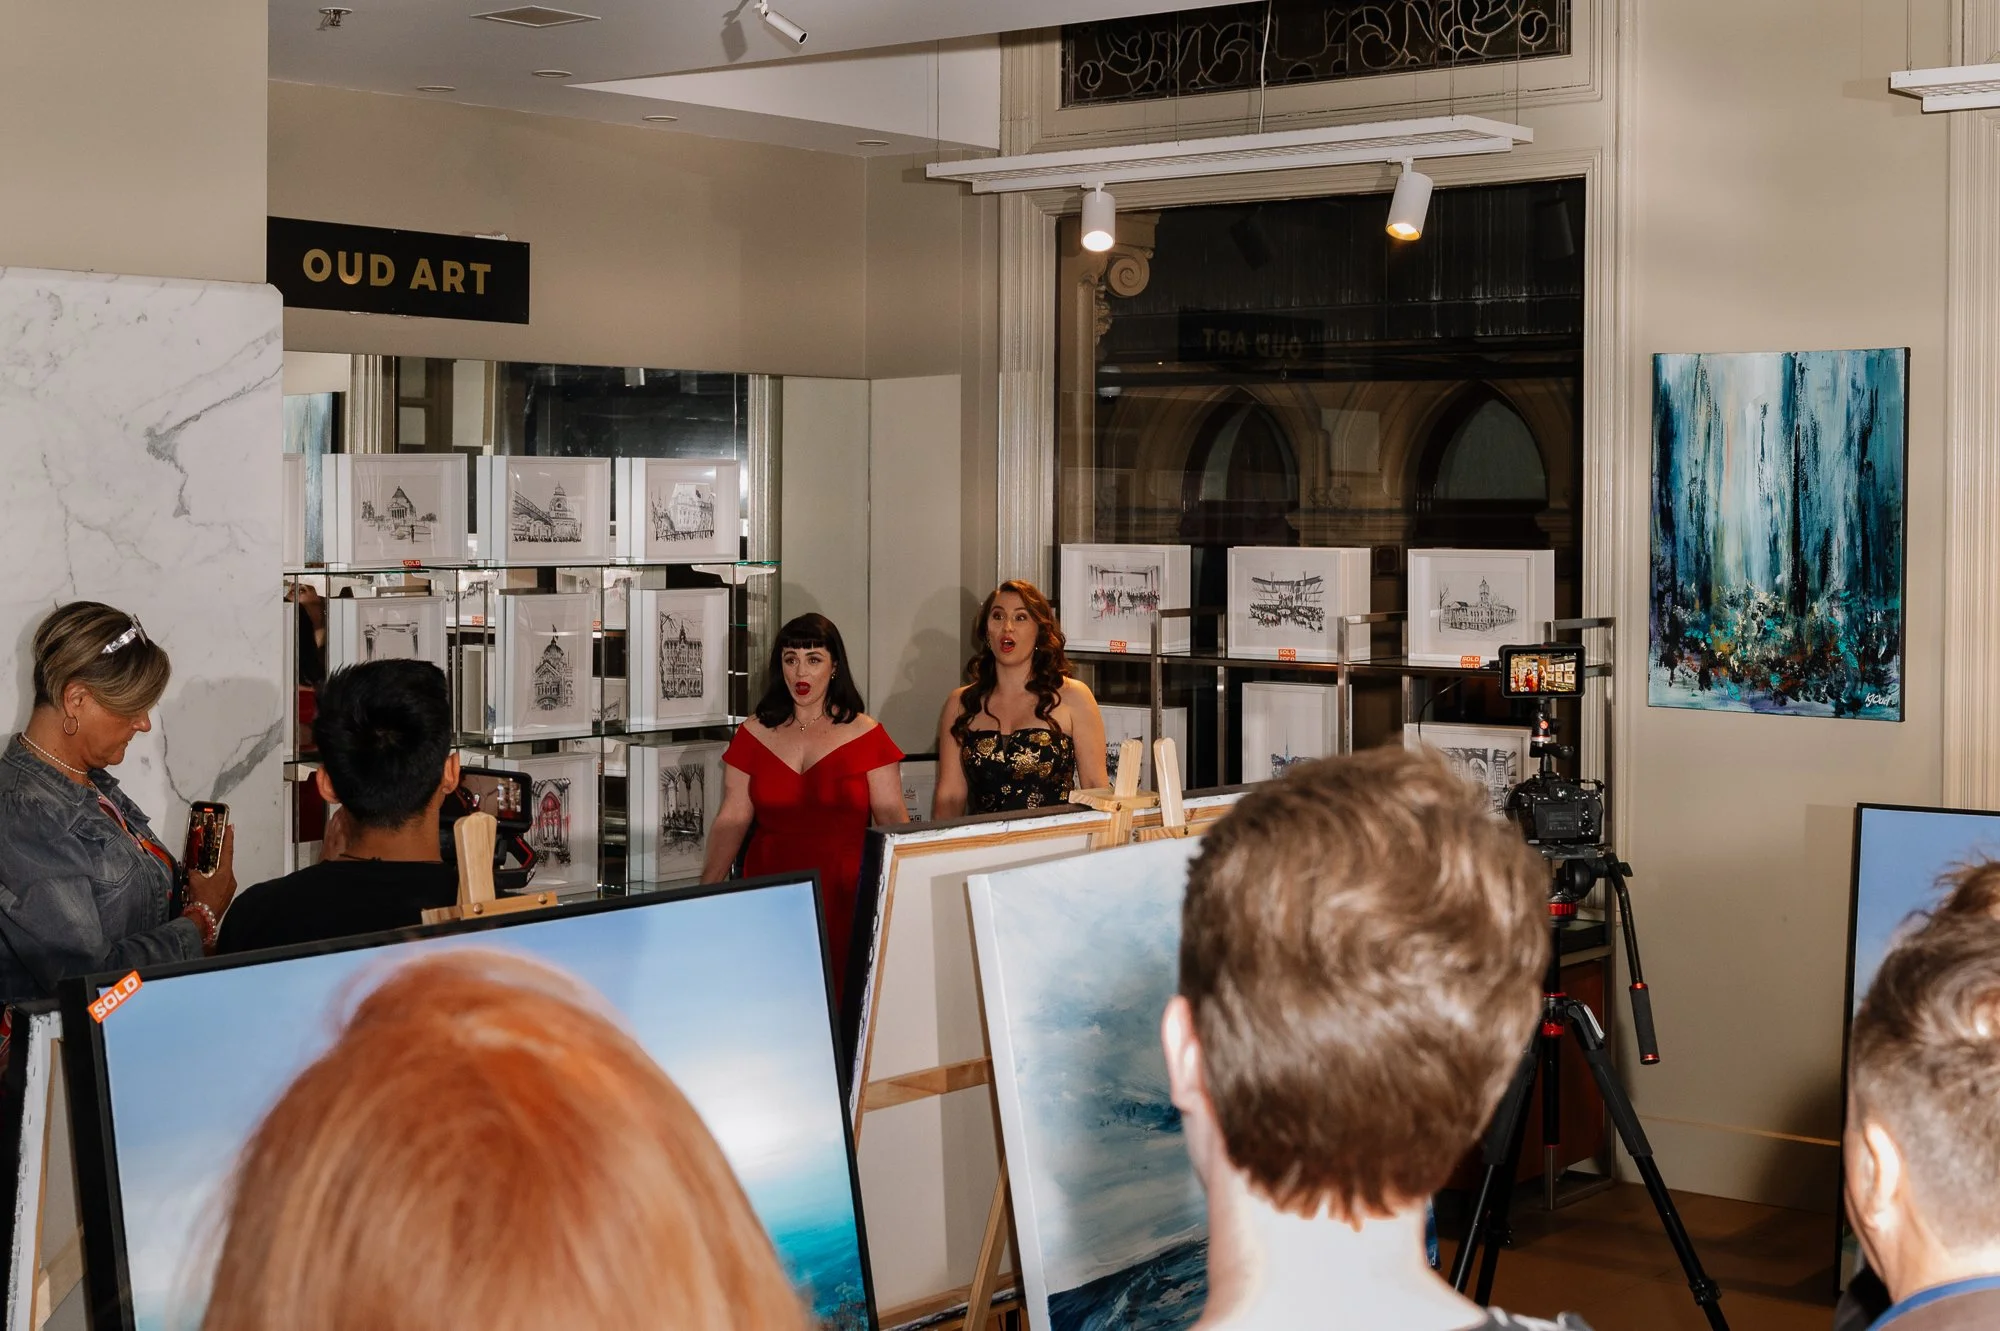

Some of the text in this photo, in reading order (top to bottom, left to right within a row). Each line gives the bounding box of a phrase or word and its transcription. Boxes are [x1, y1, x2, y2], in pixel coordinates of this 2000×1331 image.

[303, 248, 492, 295] OUD ART
[93, 976, 139, 1019] SOLD
